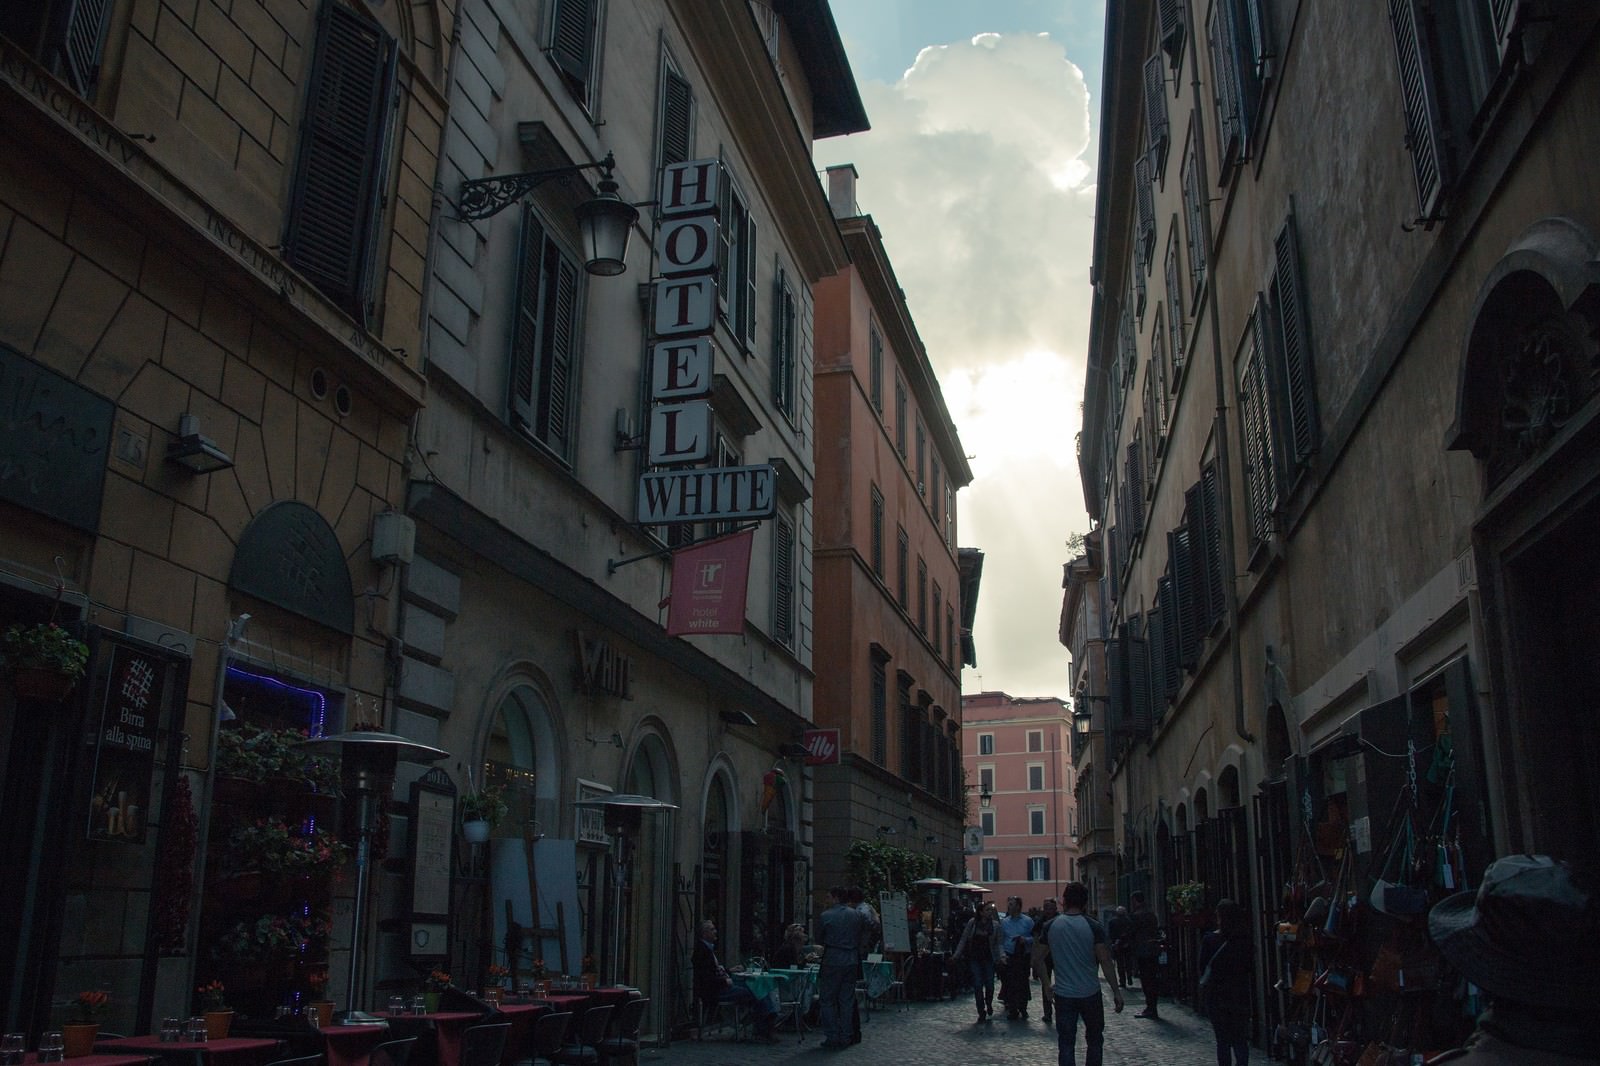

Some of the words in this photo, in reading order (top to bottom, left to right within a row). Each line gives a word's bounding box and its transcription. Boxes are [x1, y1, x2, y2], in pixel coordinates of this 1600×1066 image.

[660, 164, 713, 458] HOTEL
[642, 470, 771, 519] WHITE
[688, 617, 720, 629] white
[692, 607, 719, 618] hotel
[576, 629, 634, 700] WHITE
[119, 707, 145, 728] Birra
[105, 726, 125, 745] alla
[126, 731, 152, 752] spina
[808, 735, 835, 761] illy
